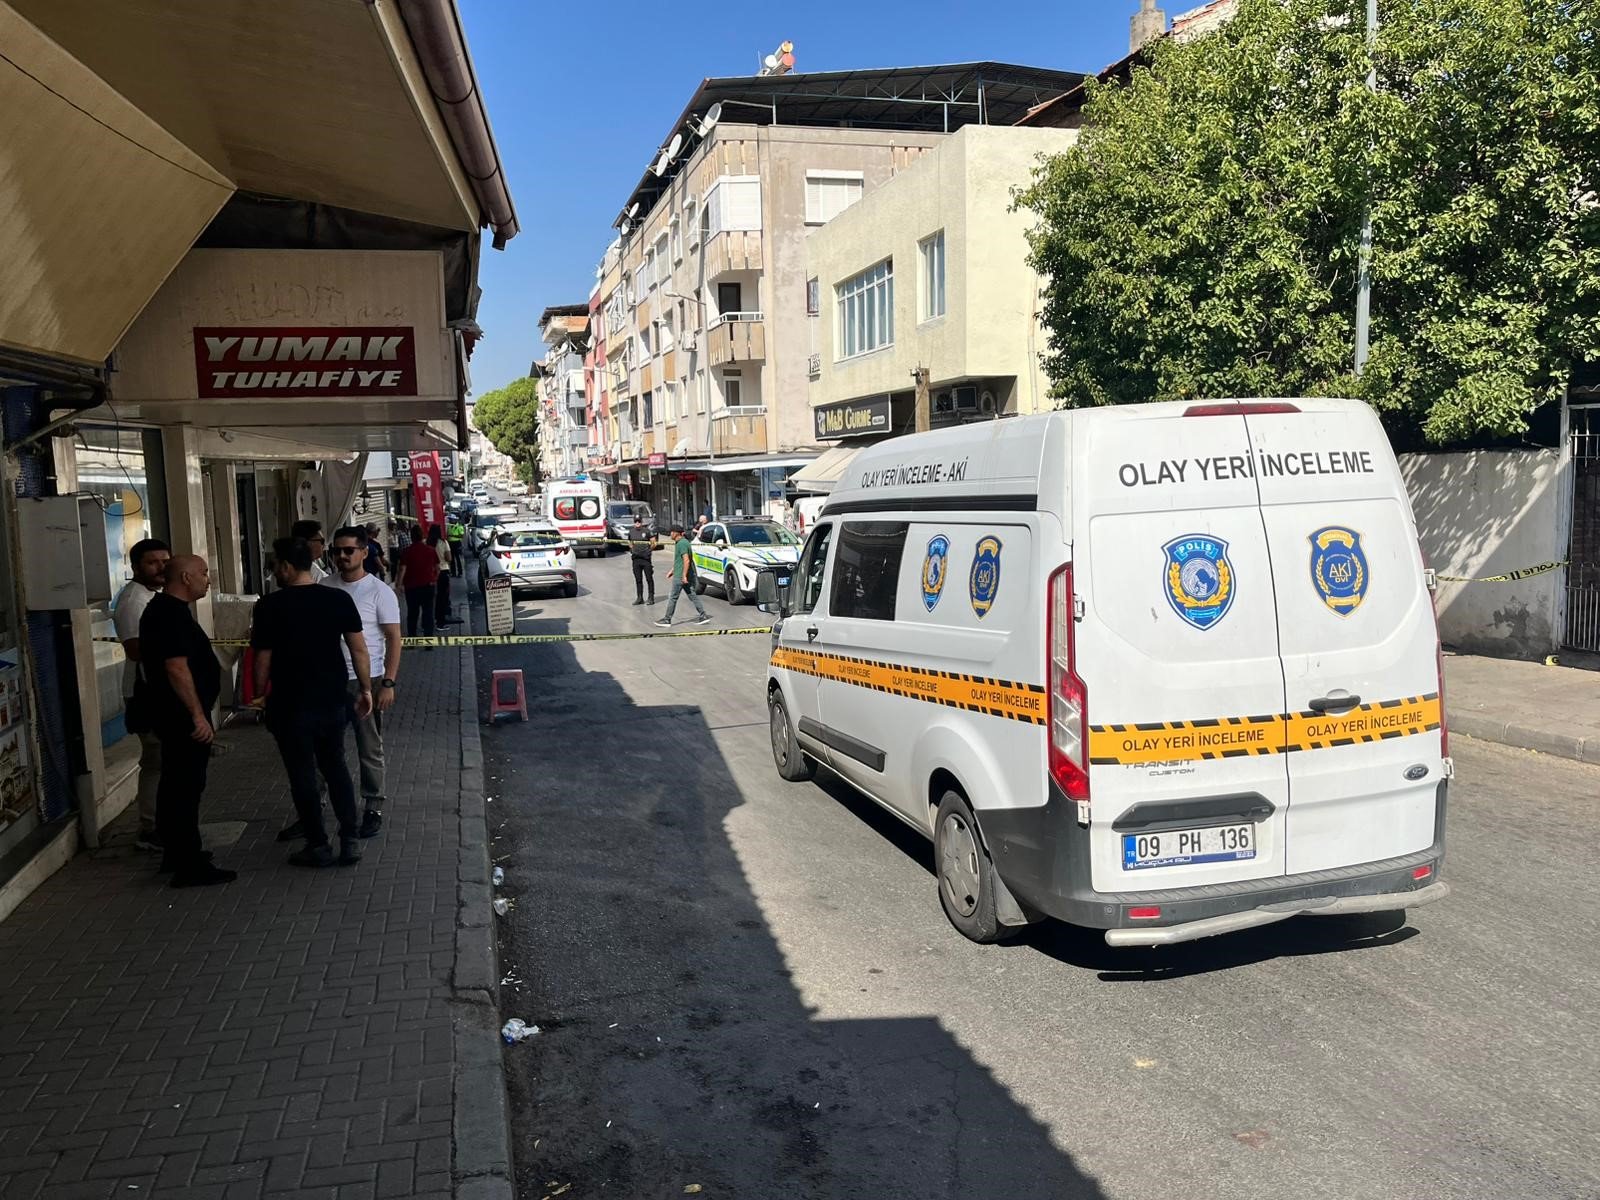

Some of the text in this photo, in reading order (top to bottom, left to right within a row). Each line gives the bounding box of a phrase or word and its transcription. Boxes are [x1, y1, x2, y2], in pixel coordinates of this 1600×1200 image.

[204, 336, 404, 361] YUMAK
[211, 367, 403, 389] TUHAFİYE
[862, 470, 881, 488] OLAY
[880, 464, 899, 487] YERİ
[898, 463, 943, 485] İNCELEME
[947, 456, 969, 482] AKİ
[1118, 448, 1374, 487] OLAY YERİ İNCELEME
[1178, 541, 1213, 553] POLİS
[1329, 560, 1352, 578] AKİ
[892, 675, 903, 685] OLAY
[971, 688, 1040, 711] OLAY YERİ İNCELEME
[1306, 710, 1423, 737] OLAY YERİ İNCELEME
[1122, 729, 1265, 752] OLAY YERİ İNCELEME
[1122, 758, 1194, 769] TRANSIT
[1148, 768, 1195, 776] CUSTOM
[1138, 826, 1249, 858] 09 PH 136
